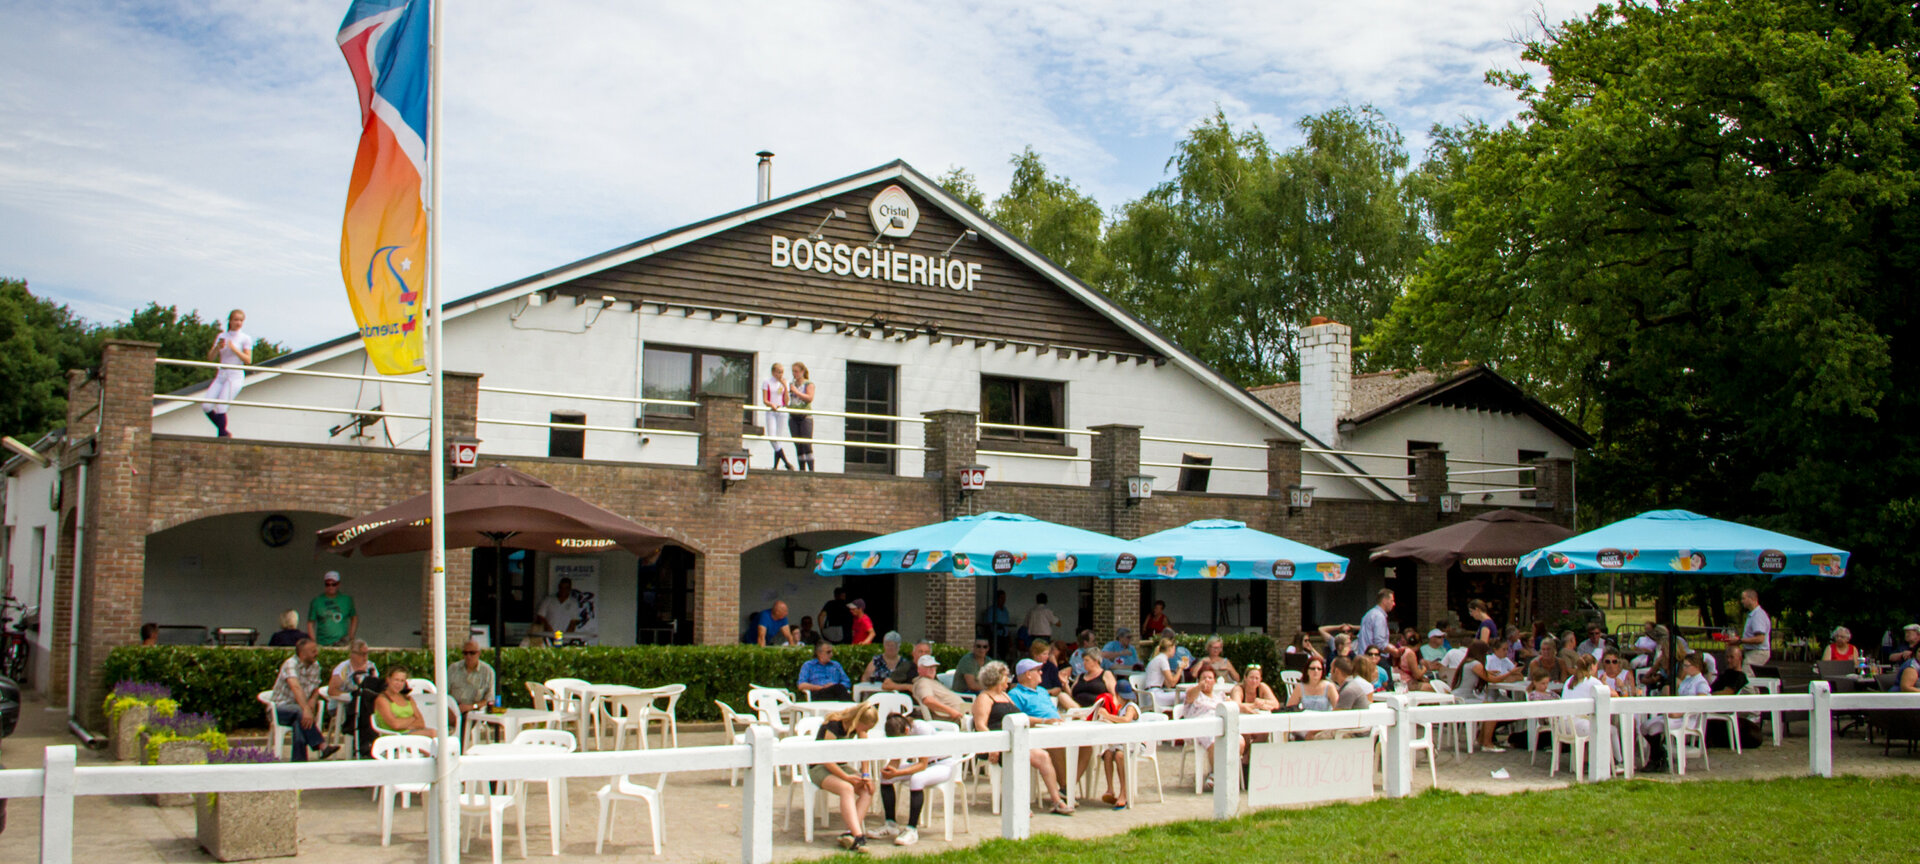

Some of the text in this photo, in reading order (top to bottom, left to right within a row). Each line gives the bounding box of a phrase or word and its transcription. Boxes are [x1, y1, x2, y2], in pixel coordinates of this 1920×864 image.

[879, 204, 910, 219] Cristal
[771, 234, 982, 292] BOSSCHERHOF
[1466, 557, 1519, 566] GRIMBERGEN
